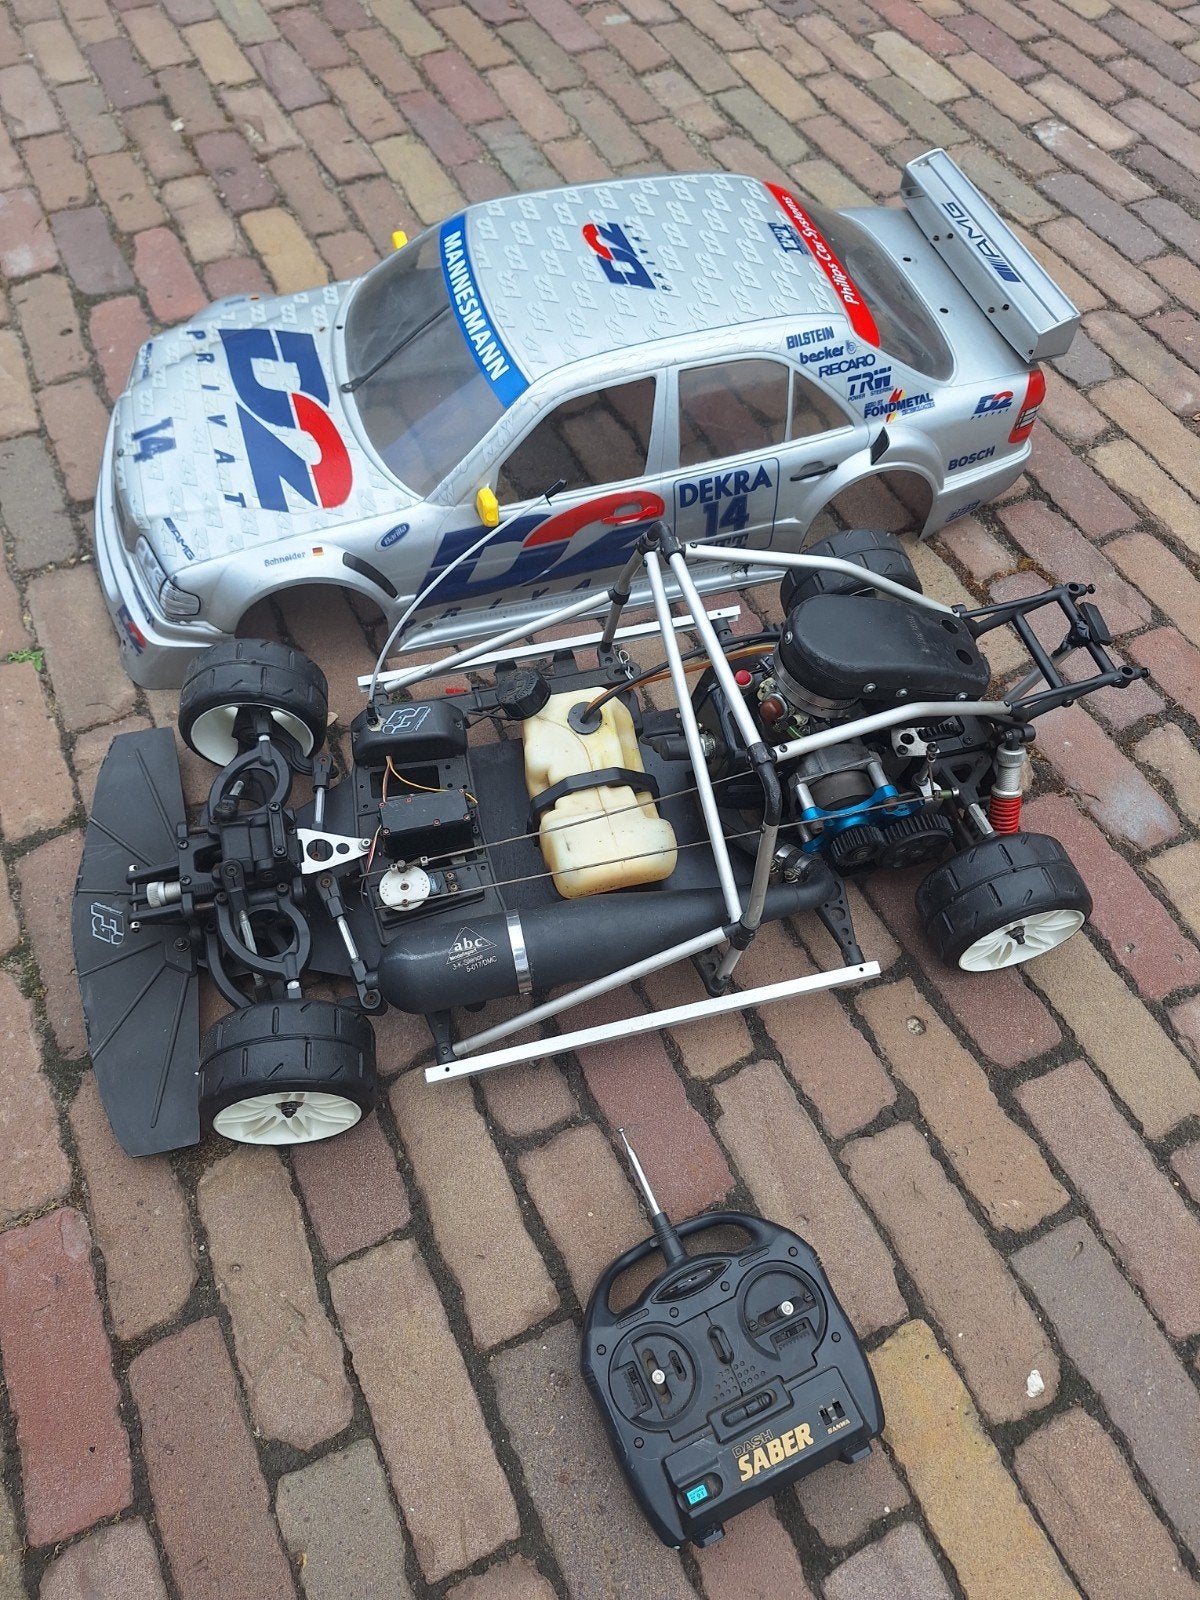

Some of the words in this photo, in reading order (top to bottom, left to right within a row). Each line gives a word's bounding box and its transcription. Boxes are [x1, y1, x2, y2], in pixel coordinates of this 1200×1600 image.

[782, 195, 818, 239] Systems
[942, 202, 1004, 263] AMG
[812, 239, 832, 261] Car
[828, 262, 859, 305] Philips
[443, 230, 511, 382] MANNESMANN
[786, 326, 835, 349] BILSTEIN
[800, 345, 844, 365] becker
[818, 353, 876, 378] RECARO
[847, 366, 892, 396] TRW
[864, 392, 934, 419] FONDMETAL
[974, 390, 1014, 415] D2
[186, 329, 247, 508] PRIVAT
[131, 416, 177, 464] 14
[948, 445, 996, 471] BOSCH
[678, 465, 773, 509] DEKRA
[703, 494, 750, 538] 14
[264, 552, 306, 568] Schneider
[454, 937, 483, 952] abc
[827, 1419, 851, 1435] SANWA
[731, 1428, 775, 1459] DASH
[738, 1422, 815, 1483] SABER
